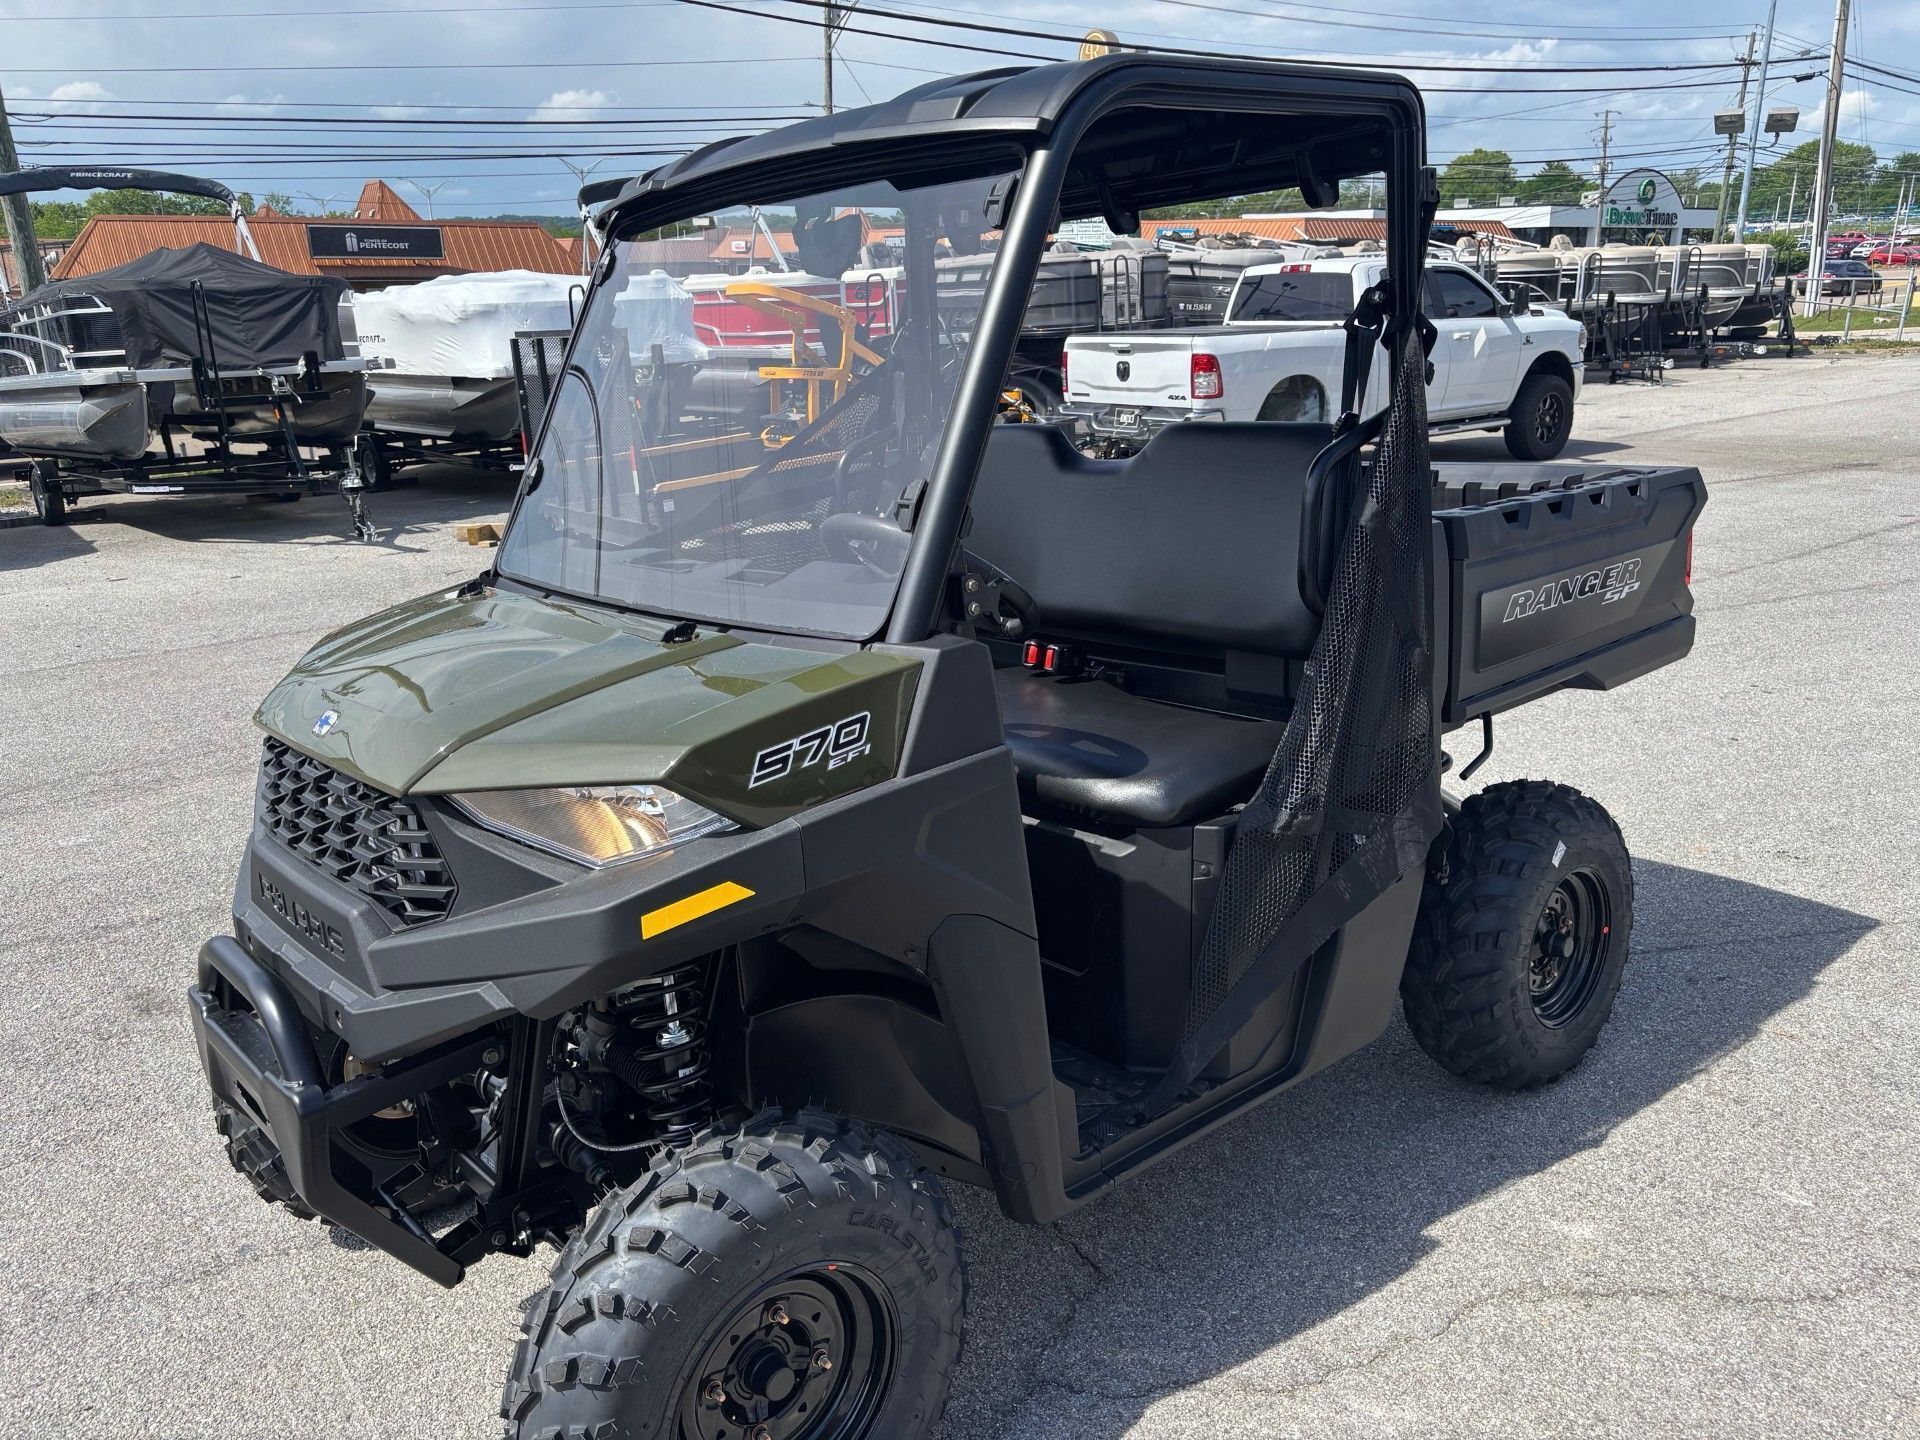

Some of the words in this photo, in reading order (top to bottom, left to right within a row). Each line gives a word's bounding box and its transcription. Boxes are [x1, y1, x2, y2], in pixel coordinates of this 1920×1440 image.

[1606, 205, 1678, 226] DriveTime
[1503, 557, 1642, 623] RANGER
[1601, 582, 1641, 605] SP
[748, 711, 871, 790] 570
[827, 743, 871, 770] EFI
[258, 872, 345, 960] POLARIS
[847, 1209, 939, 1286] CARLSTAR
